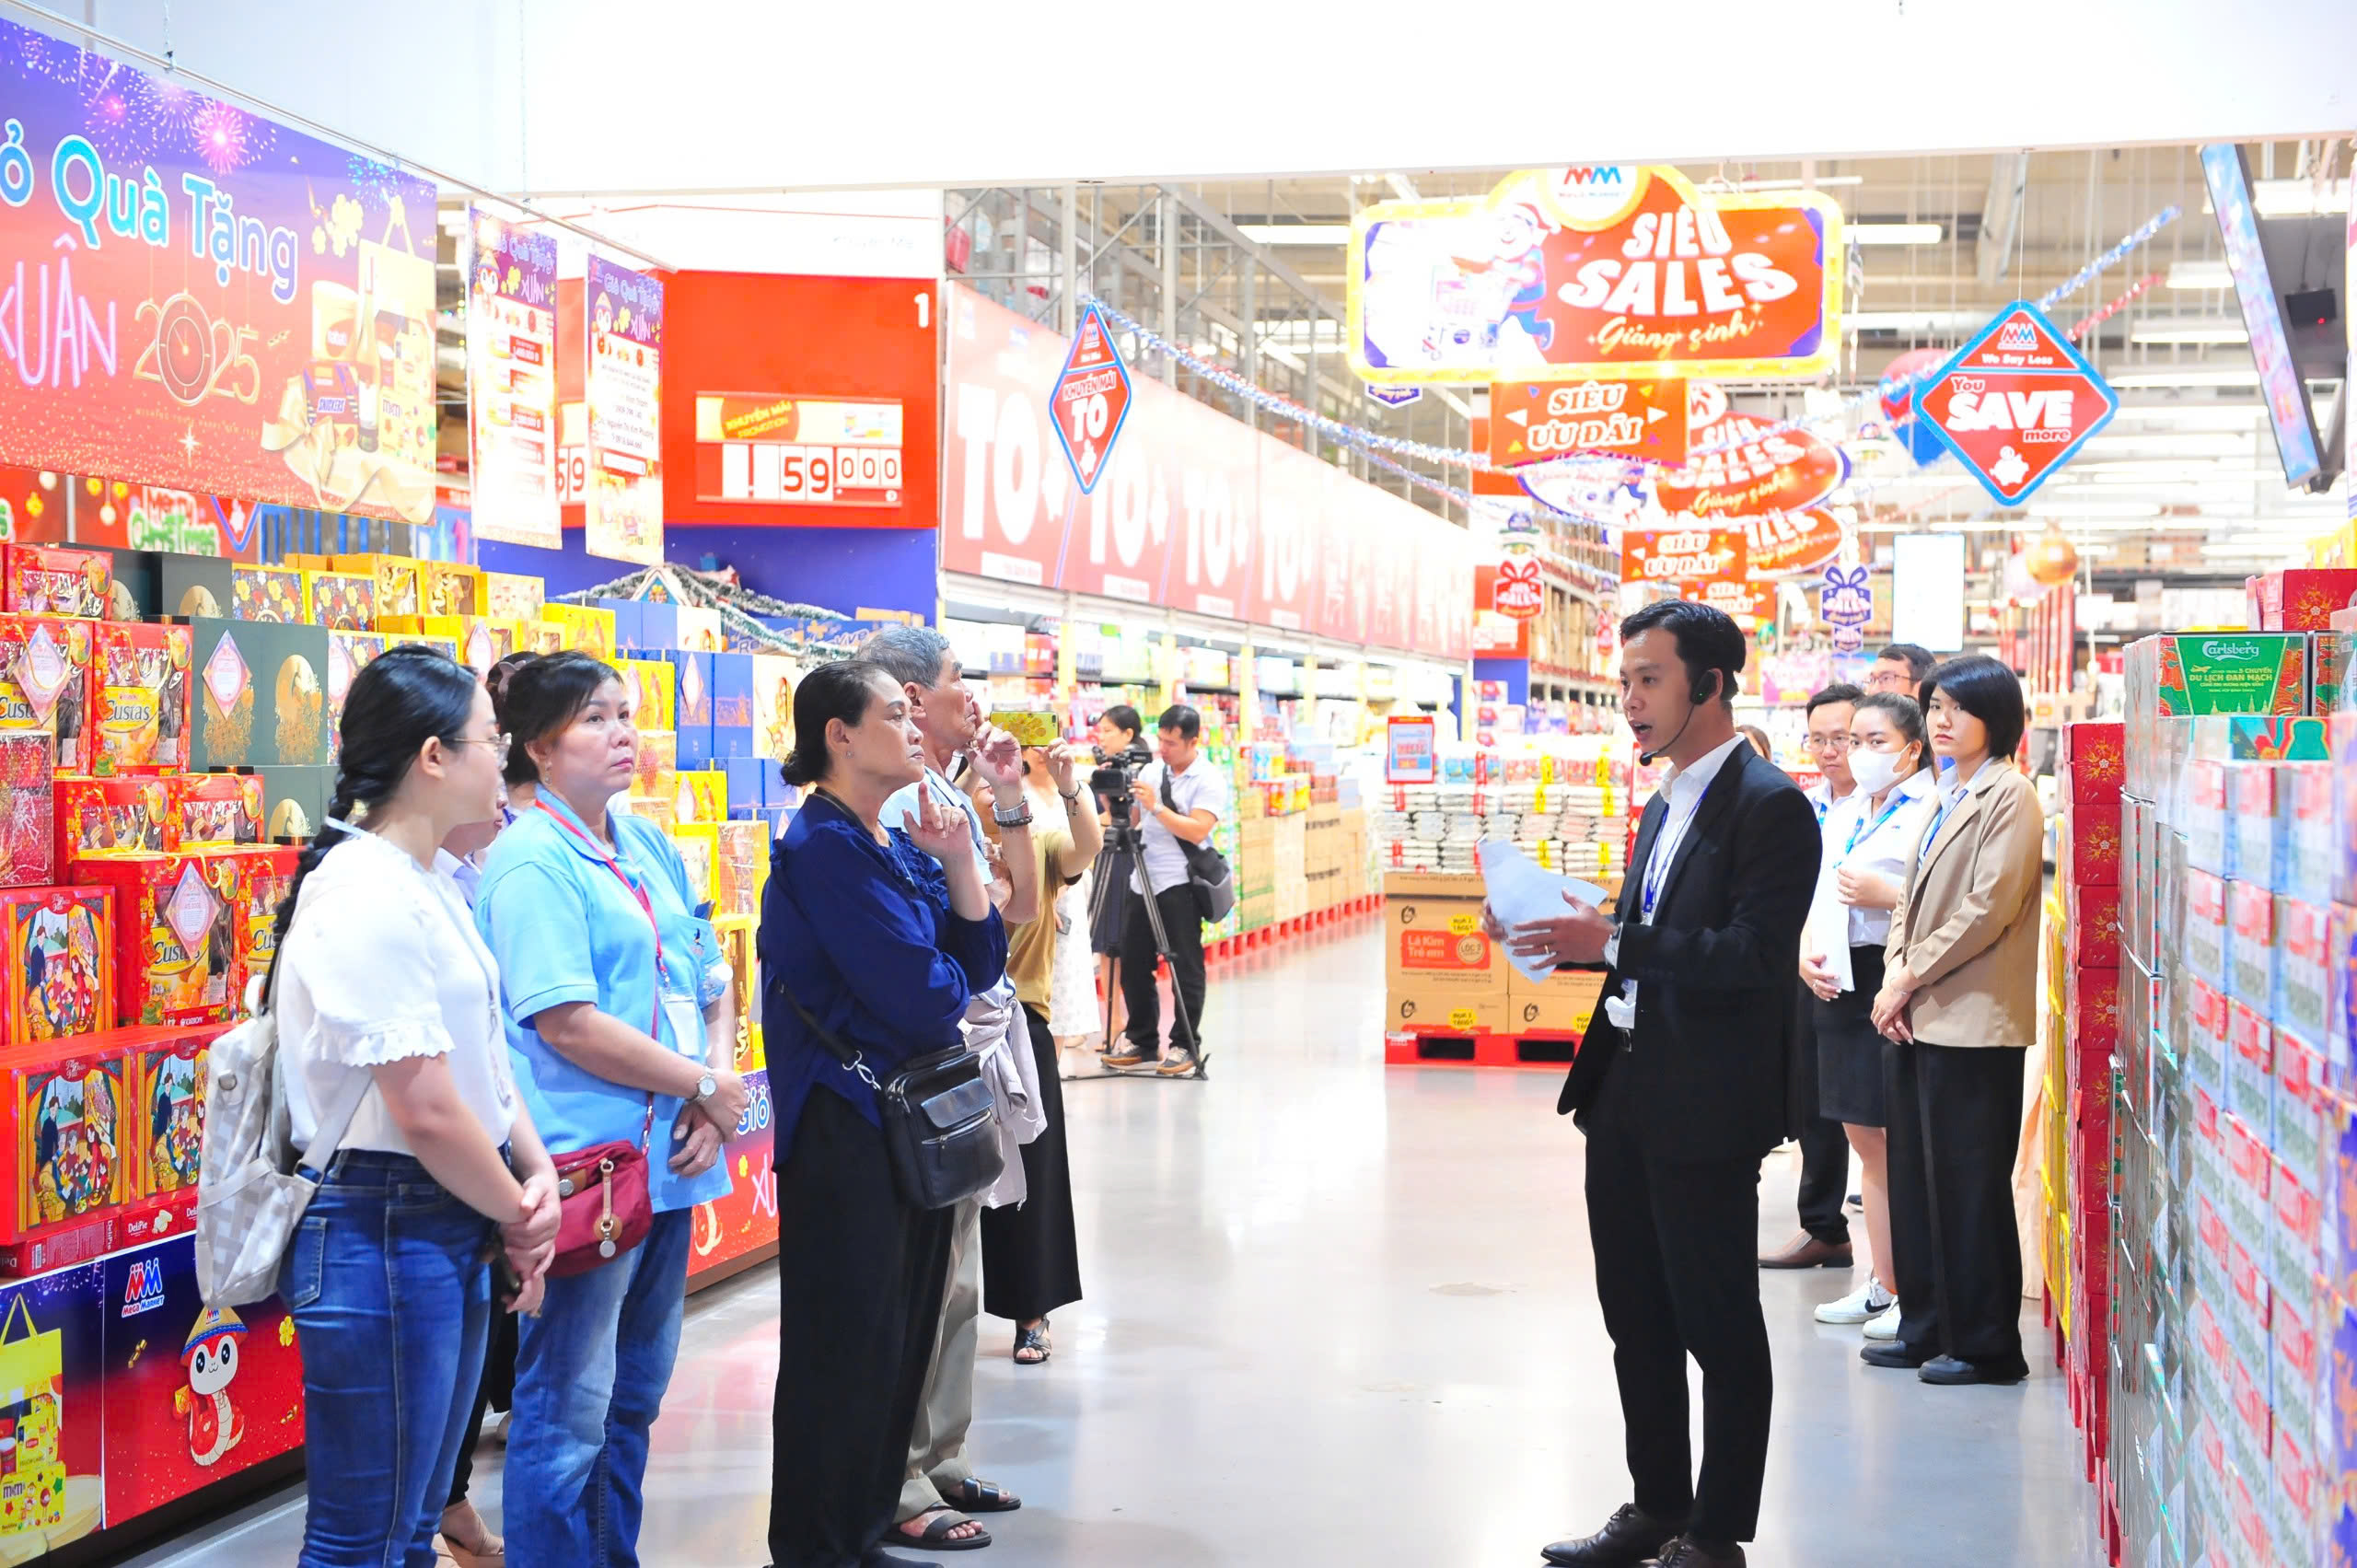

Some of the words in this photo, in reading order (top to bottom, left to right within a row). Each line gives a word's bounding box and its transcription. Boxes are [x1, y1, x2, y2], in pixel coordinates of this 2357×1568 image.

[52, 134, 169, 250] Quà
[181, 172, 298, 304] Tặng
[1622, 203, 1733, 260] SIÊU
[1557, 252, 1798, 318] SALES
[914, 293, 930, 328] 1
[133, 290, 261, 406] 2025
[1689, 309, 1757, 353] sinh
[1548, 381, 1628, 415] SIÊU
[1951, 376, 1985, 393] You
[1071, 393, 1109, 442] TO
[1945, 390, 2074, 431] SAVE
[1527, 419, 1578, 452] ƯU
[1578, 412, 1644, 448] ĐÃI
[2024, 429, 2072, 443] more
[783, 456, 830, 494] 59
[958, 382, 1041, 545] TO
[2202, 641, 2259, 658] Carlsberg
[107, 700, 150, 721] Custas
[128, 1221, 148, 1233] DeliPie
